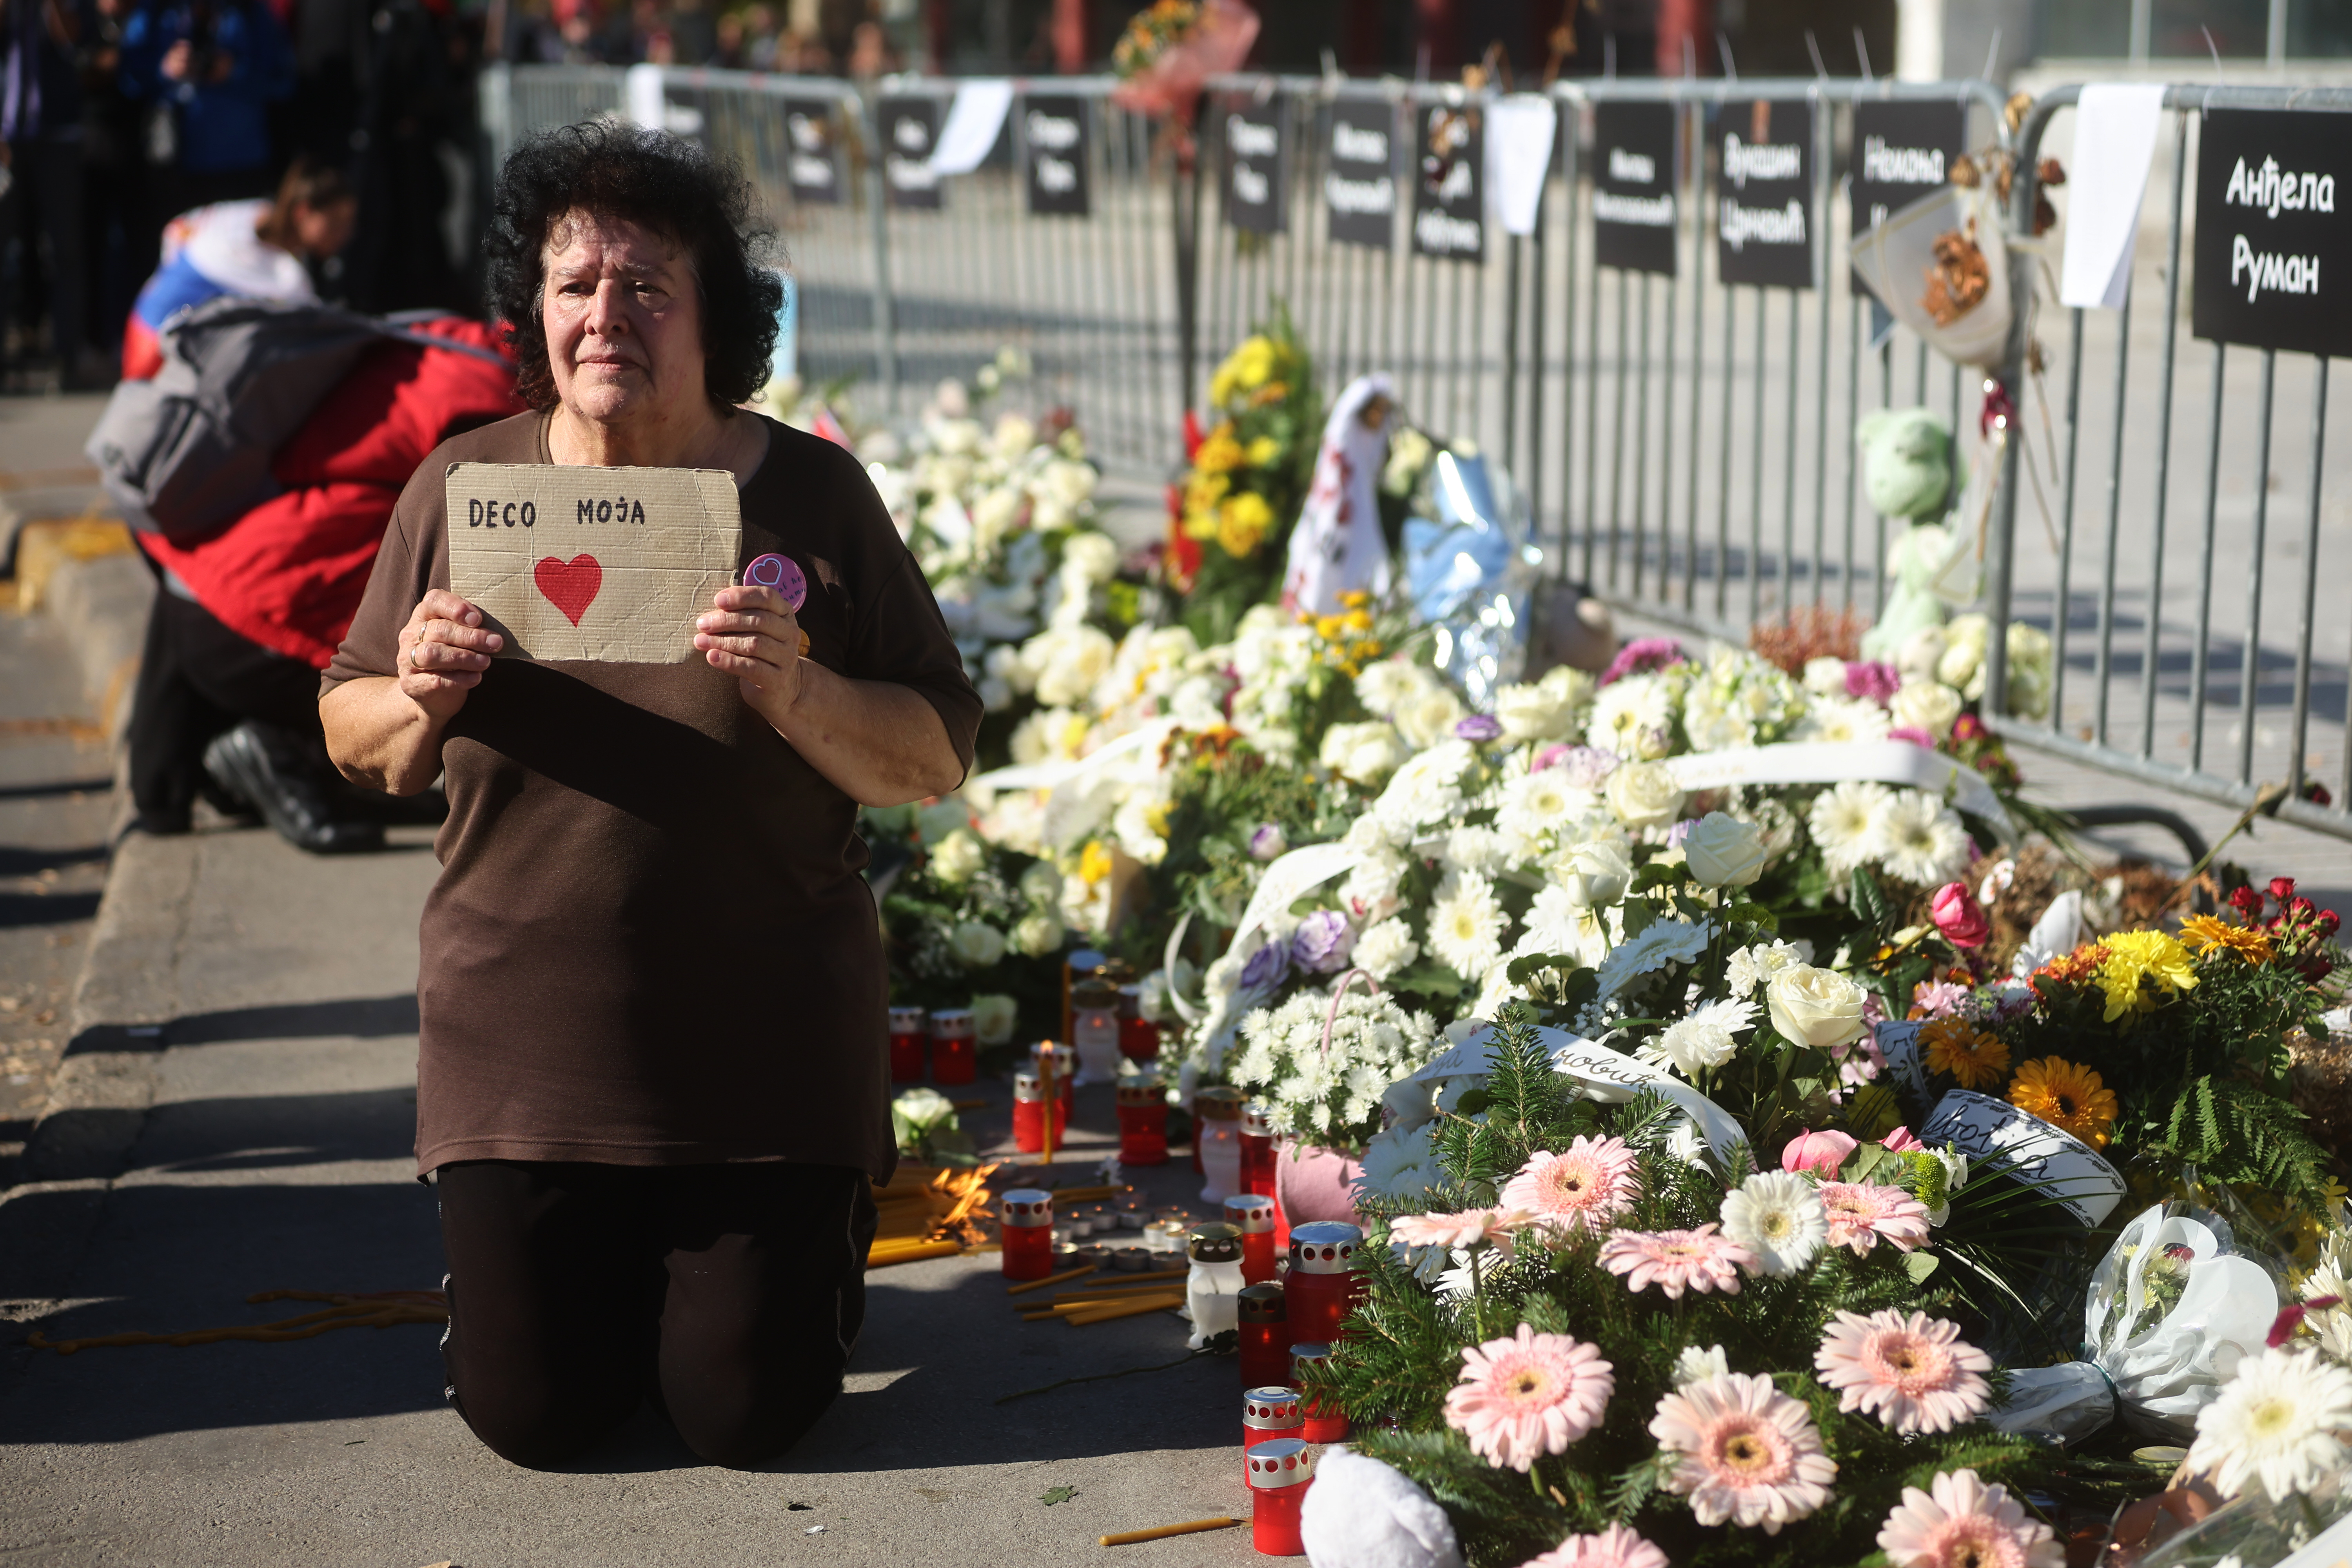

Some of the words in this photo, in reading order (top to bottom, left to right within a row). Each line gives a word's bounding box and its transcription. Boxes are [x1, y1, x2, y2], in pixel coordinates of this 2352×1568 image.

[2225, 154, 2335, 219] Анђела
[2231, 234, 2319, 303] Руман
[469, 499, 536, 528] DECO
[577, 496, 645, 525] MOJA
